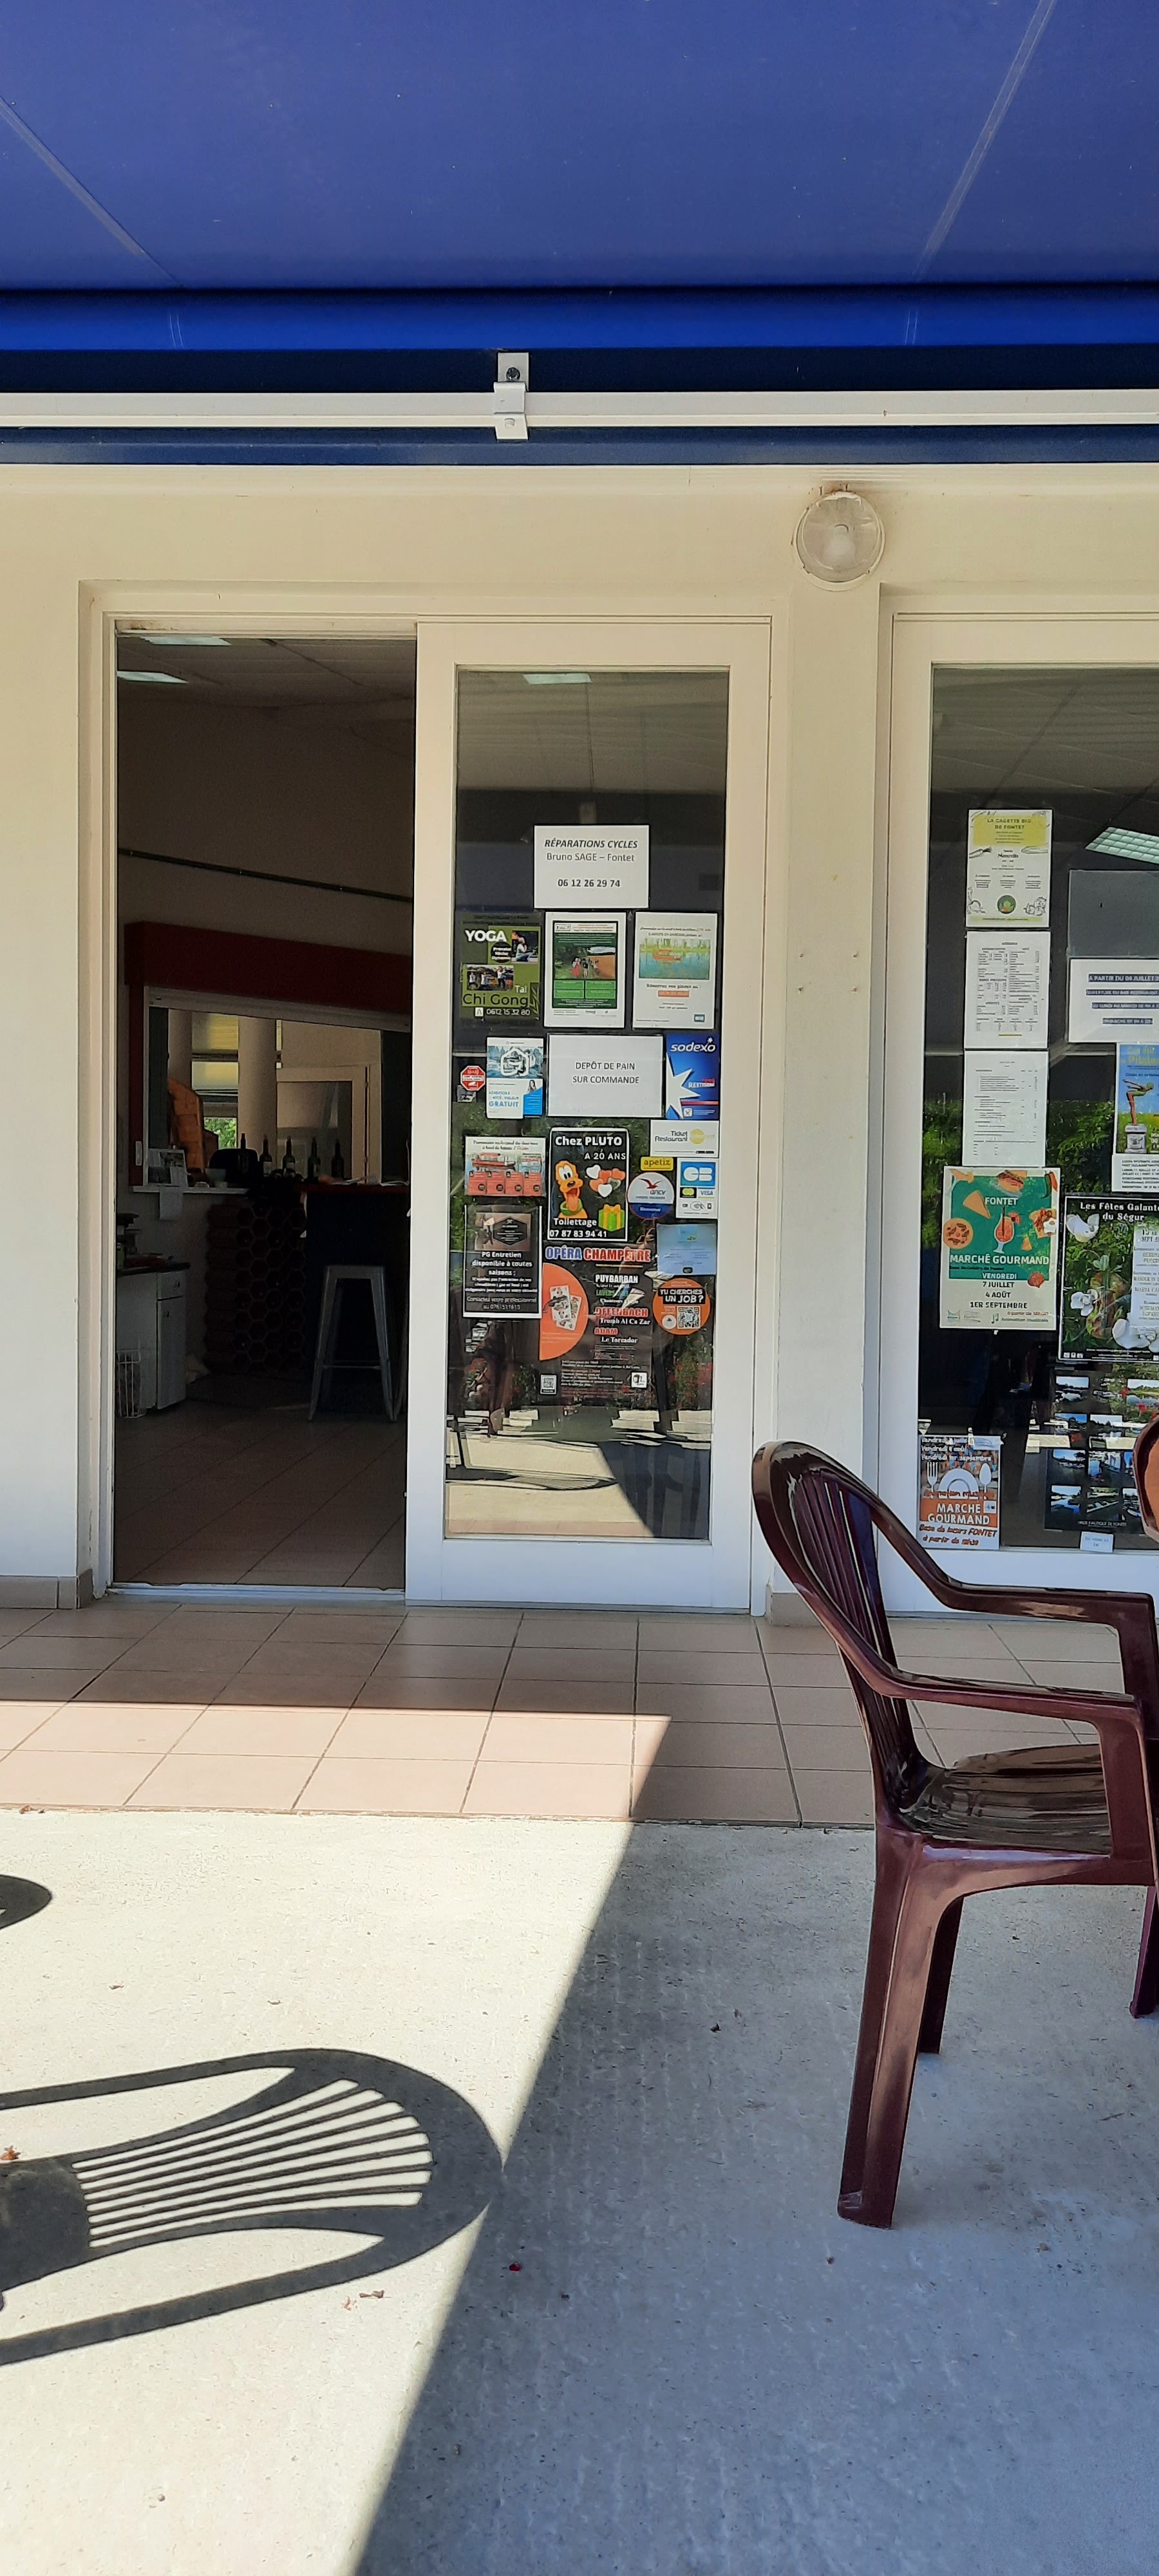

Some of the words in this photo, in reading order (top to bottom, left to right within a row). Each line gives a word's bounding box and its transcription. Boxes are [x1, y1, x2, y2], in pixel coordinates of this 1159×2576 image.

[544, 838, 605, 848] RÉPARATIONS
[607, 840, 638, 849] CYCLES
[547, 853, 572, 861] Bruno
[575, 853, 598, 862] SAGE
[607, 853, 635, 862] Fontet
[584, 879, 594, 887] 26
[465, 929, 507, 942] YOGA
[463, 993, 485, 1005] Chi
[490, 994, 529, 1008] Gong
[670, 1041, 716, 1052] sodexo
[576, 1061, 602, 1070] DEPÔT
[555, 1136, 583, 1146] Chez
[585, 1137, 623, 1146] PLUTO
[985, 1197, 1018, 1206] FONTET
[1080, 1202, 1096, 1210] Les
[1099, 1202, 1124, 1211] Fêtes
[1102, 1212, 1115, 1220] du
[1117, 1212, 1144, 1222] Ségur
[553, 1218, 598, 1227] Toilettage
[545, 1245, 582, 1260] OPÉRA
[583, 1247, 651, 1262] CHAMPÊTRE
[950, 1253, 990, 1264] MARCHÉ
[992, 1255, 1050, 1265] GOURMAND
[595, 1274, 638, 1283] PUYBARBAN
[677, 1295, 697, 1303] JOB
[594, 1307, 648, 1318] OFFENBACH
[937, 1501, 981, 1513] MARCHÉ
[928, 1513, 990, 1525] GOURMAND
[968, 1528, 997, 1537] FONTET
